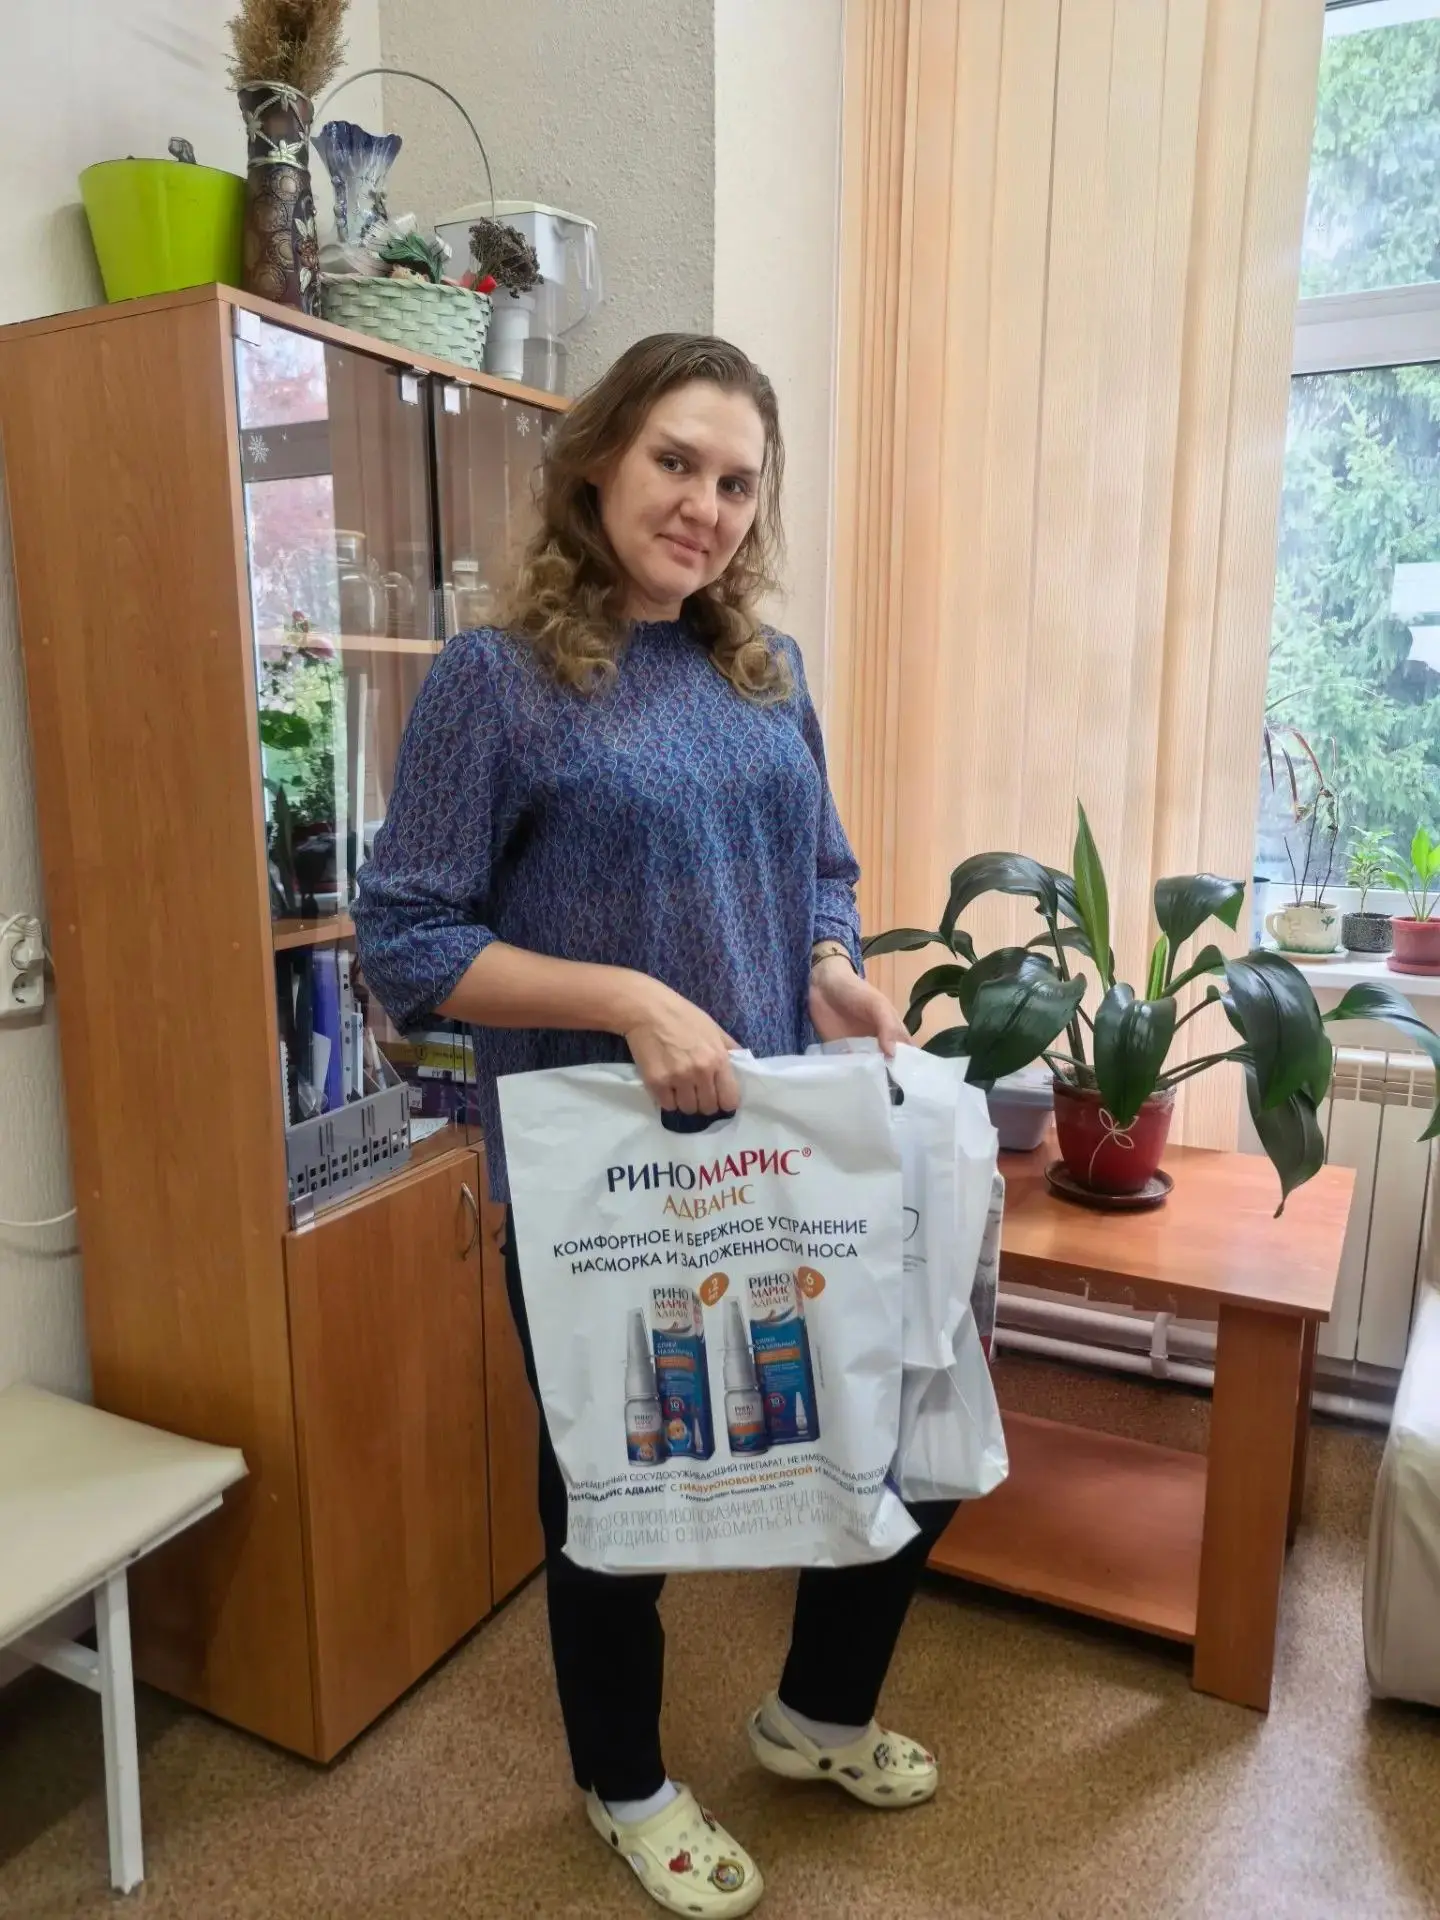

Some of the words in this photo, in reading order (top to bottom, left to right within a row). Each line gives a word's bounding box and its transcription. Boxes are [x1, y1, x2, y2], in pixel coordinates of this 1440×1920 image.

[662, 1184, 755, 1221] АДВАНС
[553, 1229, 670, 1258] КОМФОРТНОЕ
[674, 1229, 684, 1245] И
[687, 1216, 764, 1248] БЕРЕЖНОЕ
[767, 1216, 868, 1235] УСТРАНЕНИЕ
[572, 1252, 662, 1275] НАСМОРКА
[667, 1251, 678, 1265] И
[681, 1237, 804, 1268] ЗАЛОЖЕННОСТИ
[807, 1243, 858, 1258] НОСА
[748, 1273, 791, 1289] РИНО
[806, 1273, 814, 1286] 6
[652, 1287, 690, 1301] РИНО
[750, 1286, 789, 1299] МАРИС
[787, 1455, 800, 1465] НЕ
[670, 1484, 678, 1492] С
[679, 1472, 757, 1493] ГИАЛУРОНОВОЙ
[758, 1464, 813, 1483] КИСЛОТОЙ
[769, 1488, 811, 1511] ПЕРЕД
[675, 1513, 792, 1543] ОЗНАКОМИТЬСЯ
